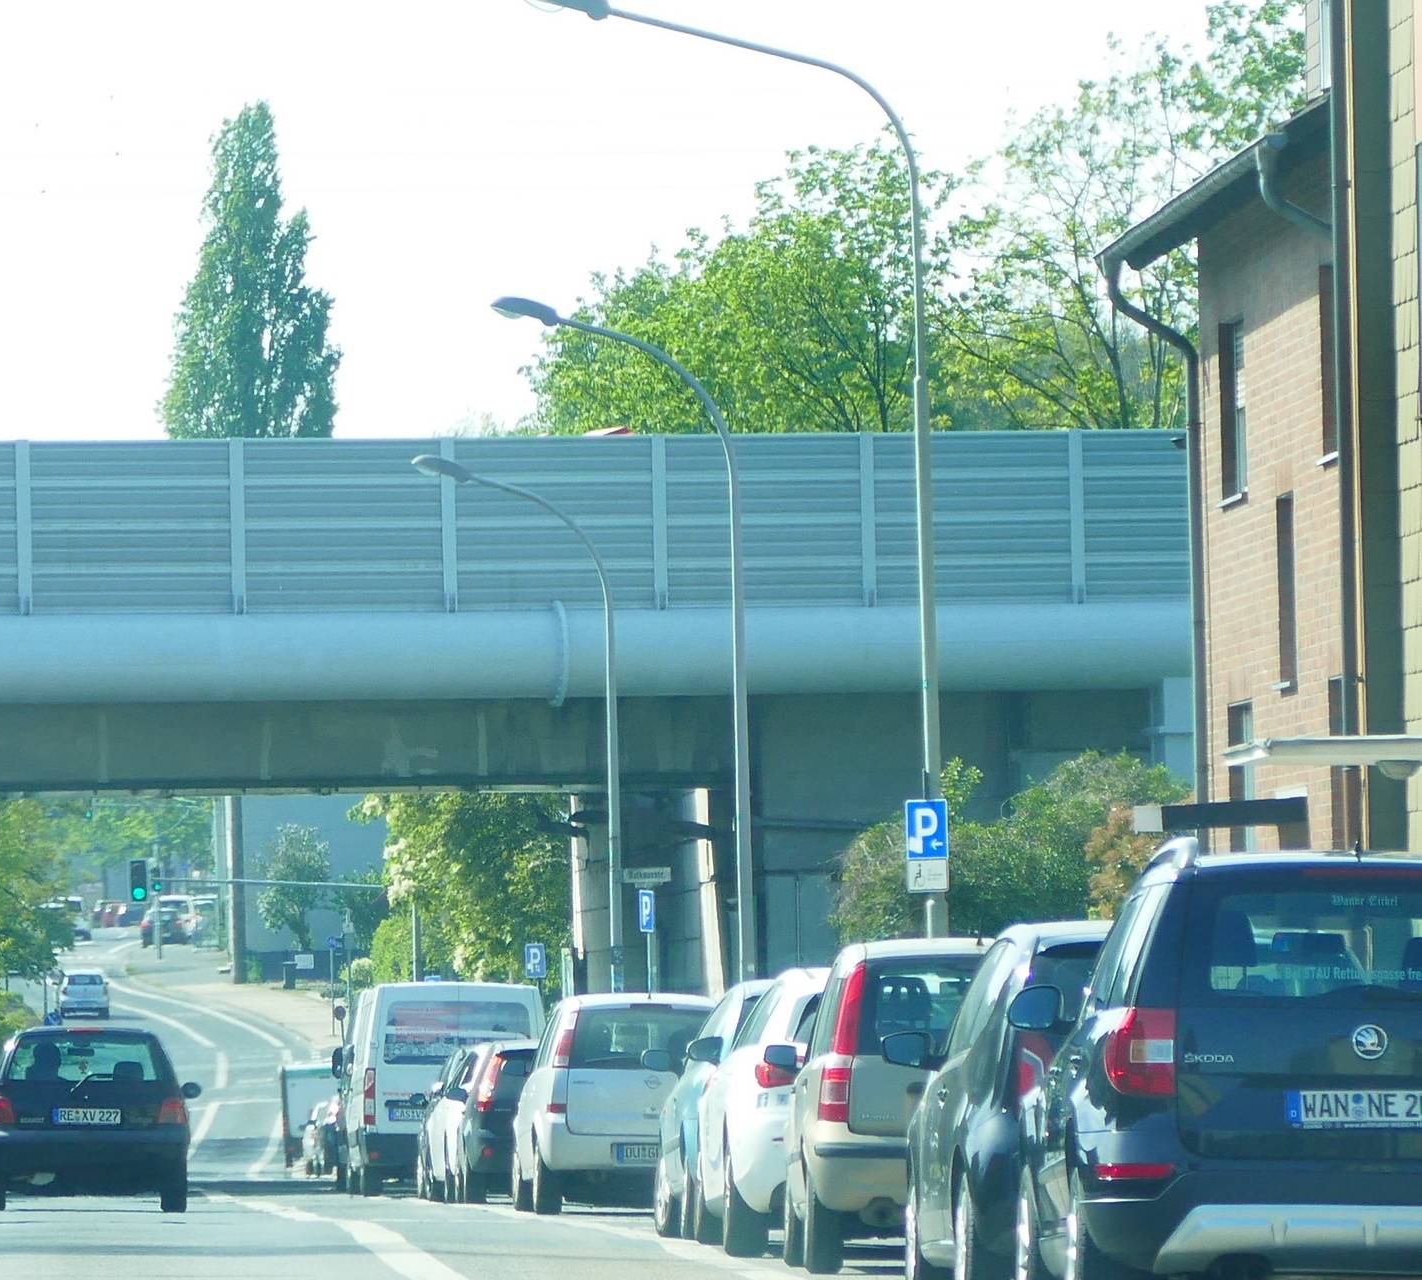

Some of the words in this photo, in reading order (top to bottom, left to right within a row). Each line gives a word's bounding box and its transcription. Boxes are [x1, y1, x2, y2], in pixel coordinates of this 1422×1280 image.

[1305, 967, 1330, 979] STAU
[1184, 1052, 1234, 1063] ŠKODA
[1302, 1093, 1349, 1118] WAN
[1368, 1093, 1398, 1118] NE
[1405, 1094, 1422, 1117] 2
[60, 1110, 73, 1121] RE
[82, 1111, 95, 1121] XV
[99, 1111, 118, 1122] 227
